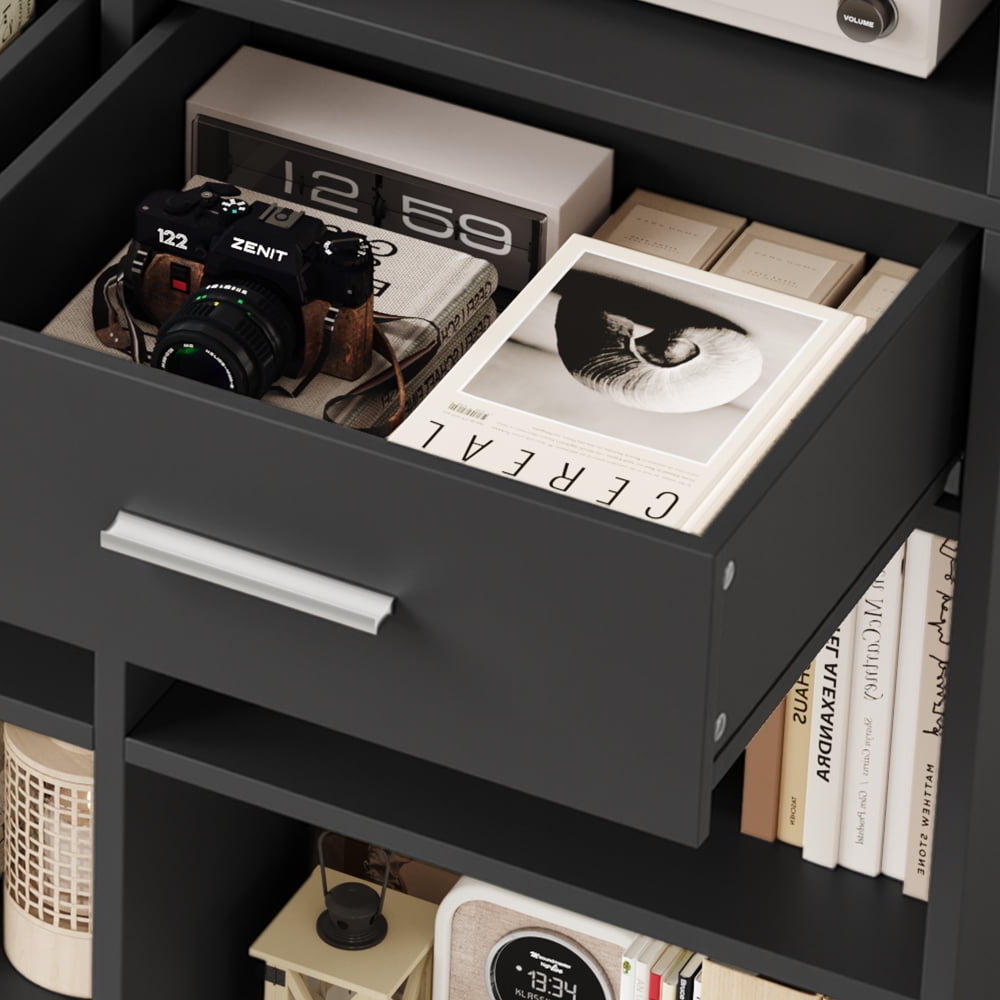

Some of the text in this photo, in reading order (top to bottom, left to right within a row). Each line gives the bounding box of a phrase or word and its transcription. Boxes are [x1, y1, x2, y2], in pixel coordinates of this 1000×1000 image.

[843, 14, 875, 29] VOLUME
[281, 159, 513, 257] 12 59
[157, 227, 189, 251] 122
[230, 236, 289, 263] ZENIT
[421, 420, 680, 520] CEREAL
[528, 970, 577, 1000] 13:34
